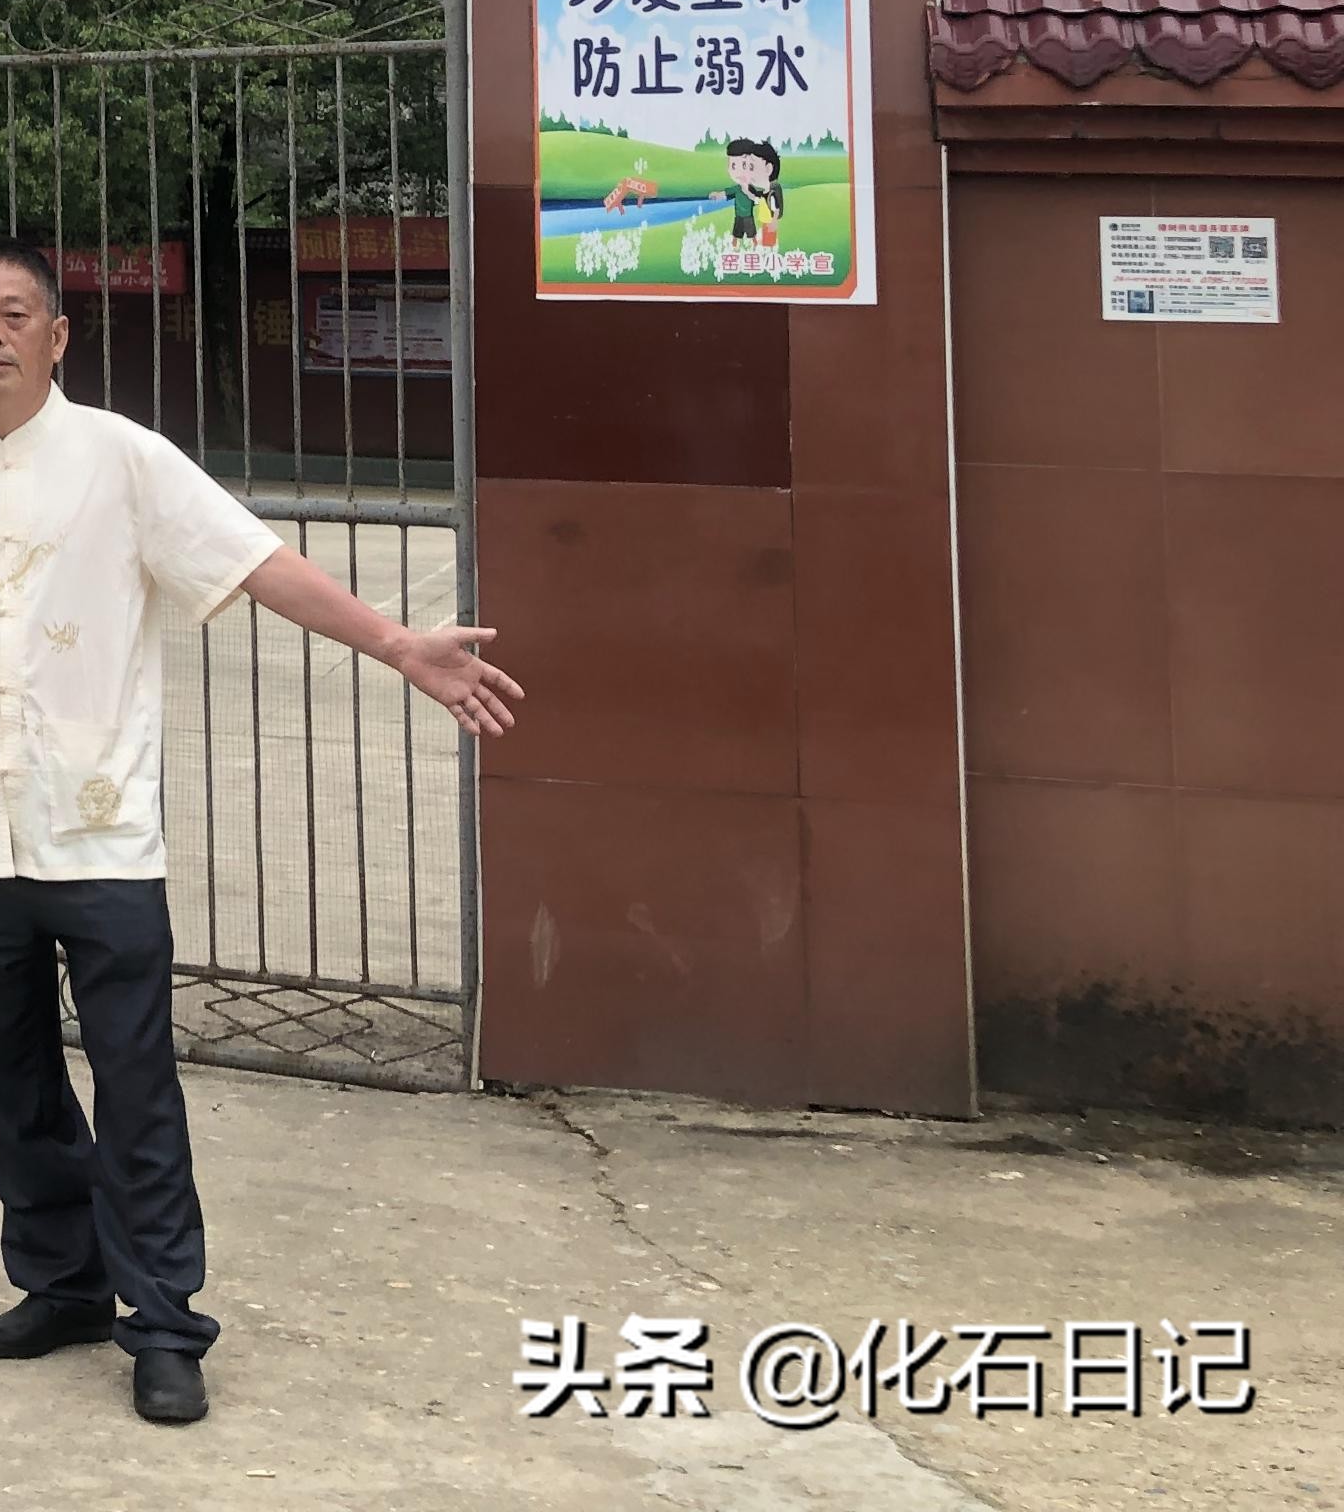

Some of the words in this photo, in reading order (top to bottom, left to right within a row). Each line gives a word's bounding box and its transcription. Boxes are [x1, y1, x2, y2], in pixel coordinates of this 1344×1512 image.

[573, 34, 808, 97] 防止溺水
[721, 253, 832, 272] 窑里小学宣
